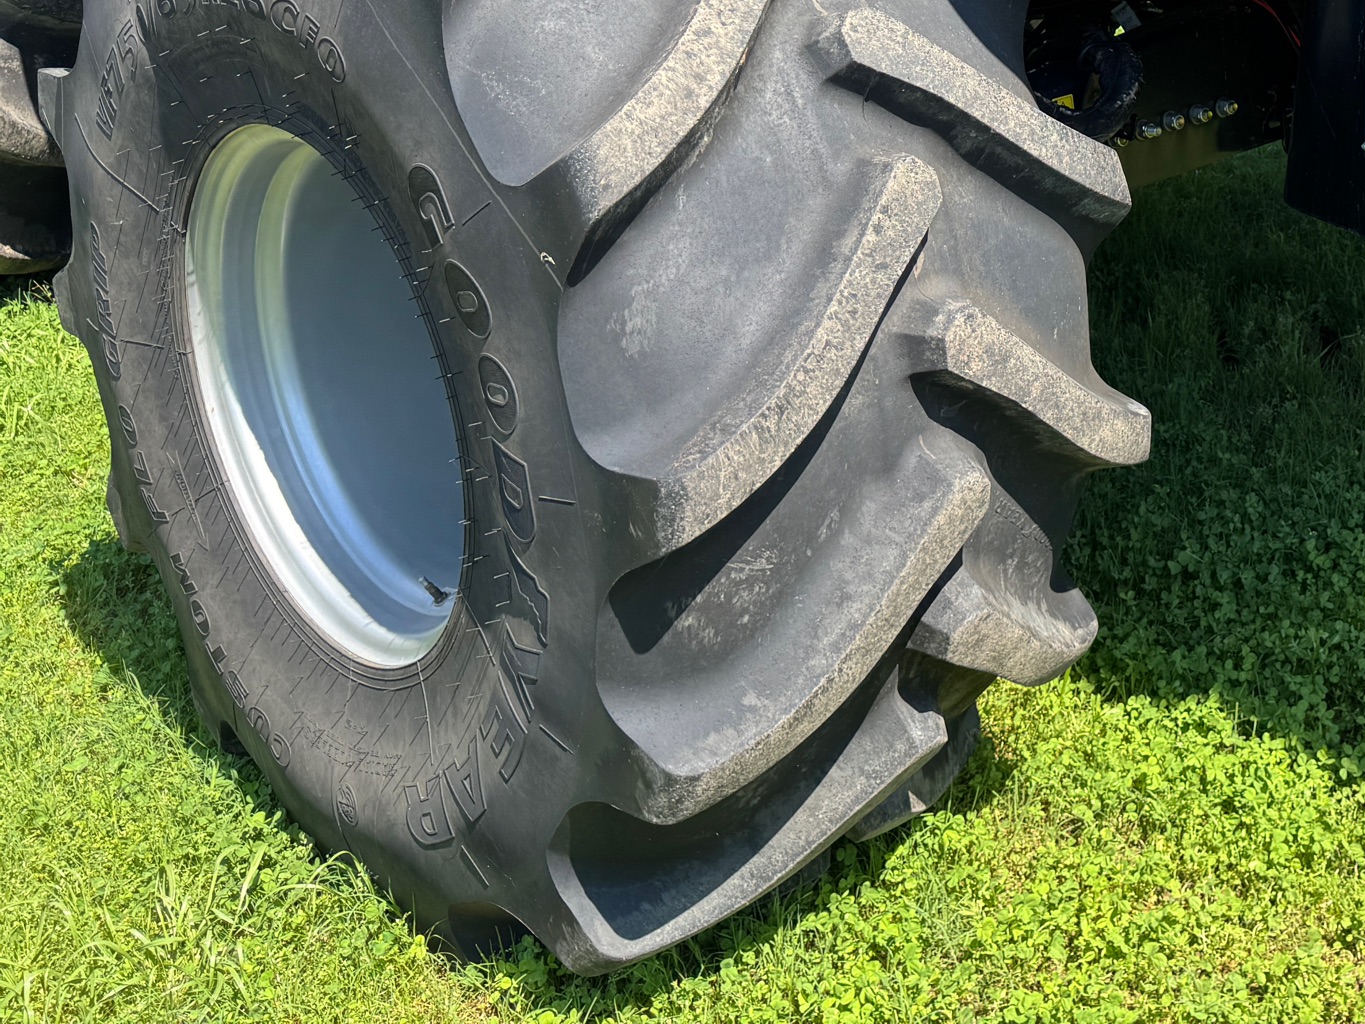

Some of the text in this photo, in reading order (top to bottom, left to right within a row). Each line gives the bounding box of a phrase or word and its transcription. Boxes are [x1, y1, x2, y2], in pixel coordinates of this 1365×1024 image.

[90, 220, 292, 767] CUSTOM FLO GRIP
[407, 162, 551, 845] GOODYEAR
